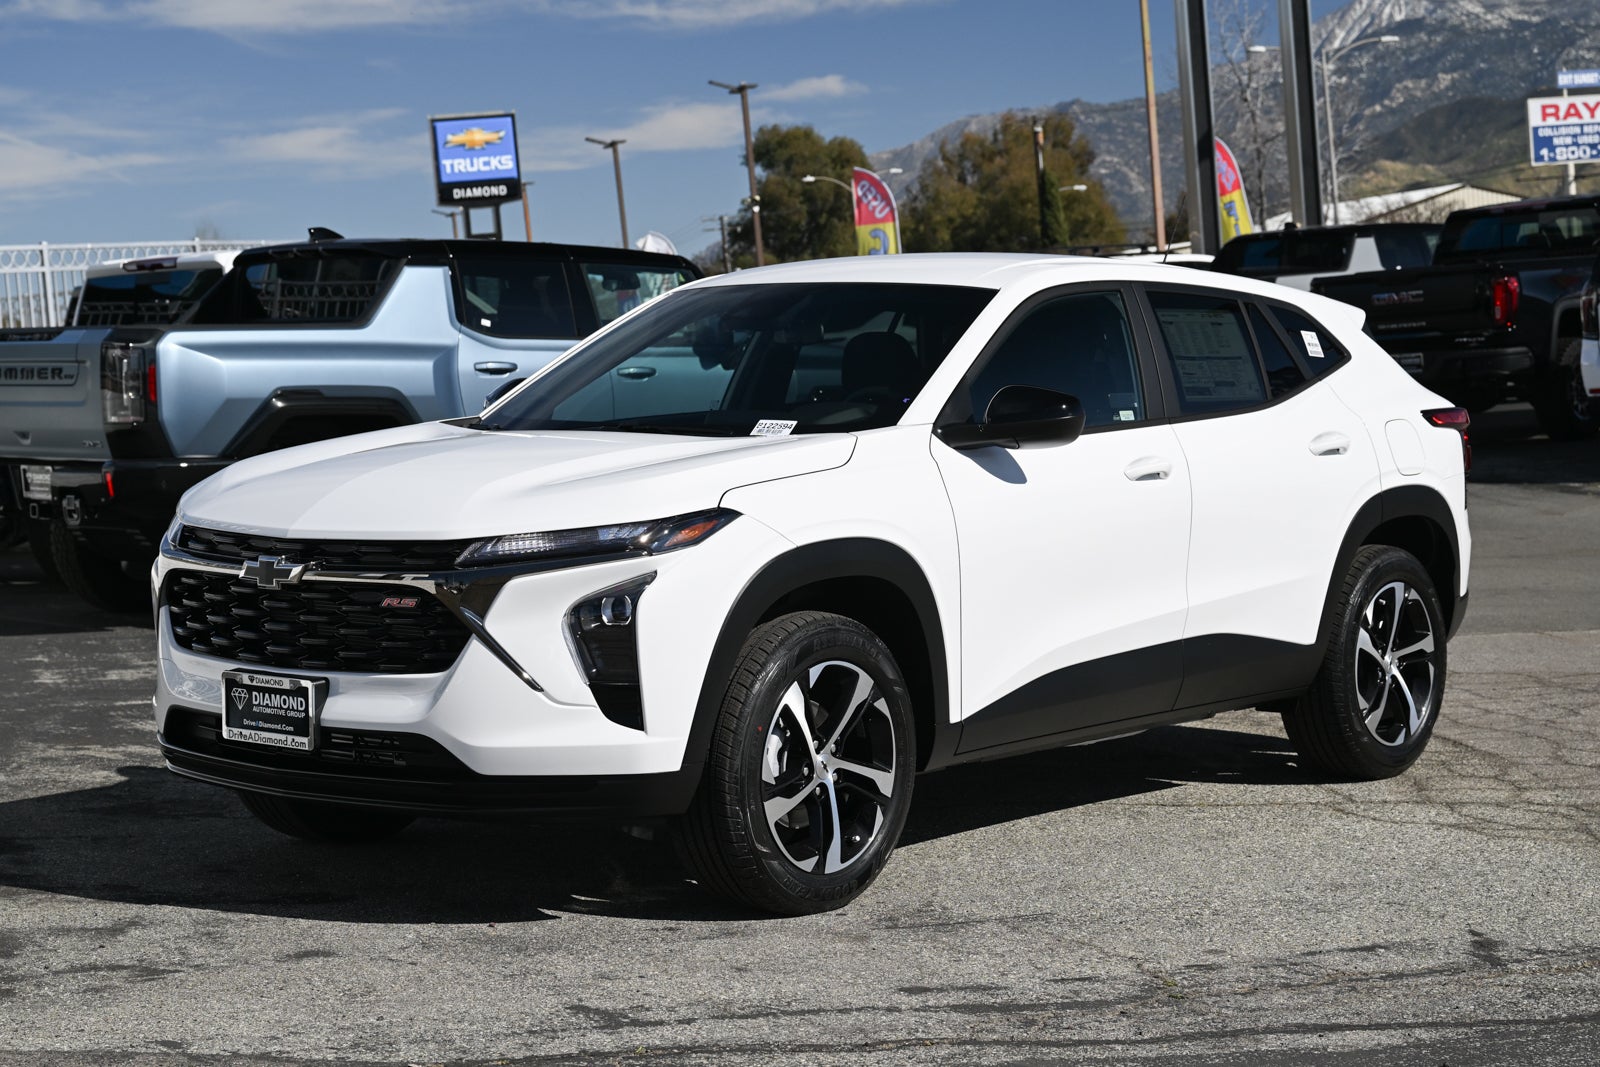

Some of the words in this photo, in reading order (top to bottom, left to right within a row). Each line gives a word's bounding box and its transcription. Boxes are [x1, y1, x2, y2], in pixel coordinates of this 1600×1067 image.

[1539, 145, 1600, 162] 1-800-
[442, 155, 513, 174] TRUCKS
[453, 184, 507, 200] DIAMOND
[0, 367, 64, 380] MMER
[382, 597, 418, 608] RS
[255, 676, 284, 687] DIAMOND
[252, 691, 306, 711] DIAMOND
[252, 705, 286, 717] AUTOMOTIVE
[286, 710, 306, 719] GROUP
[228, 729, 307, 749] DriveADiamond.com
